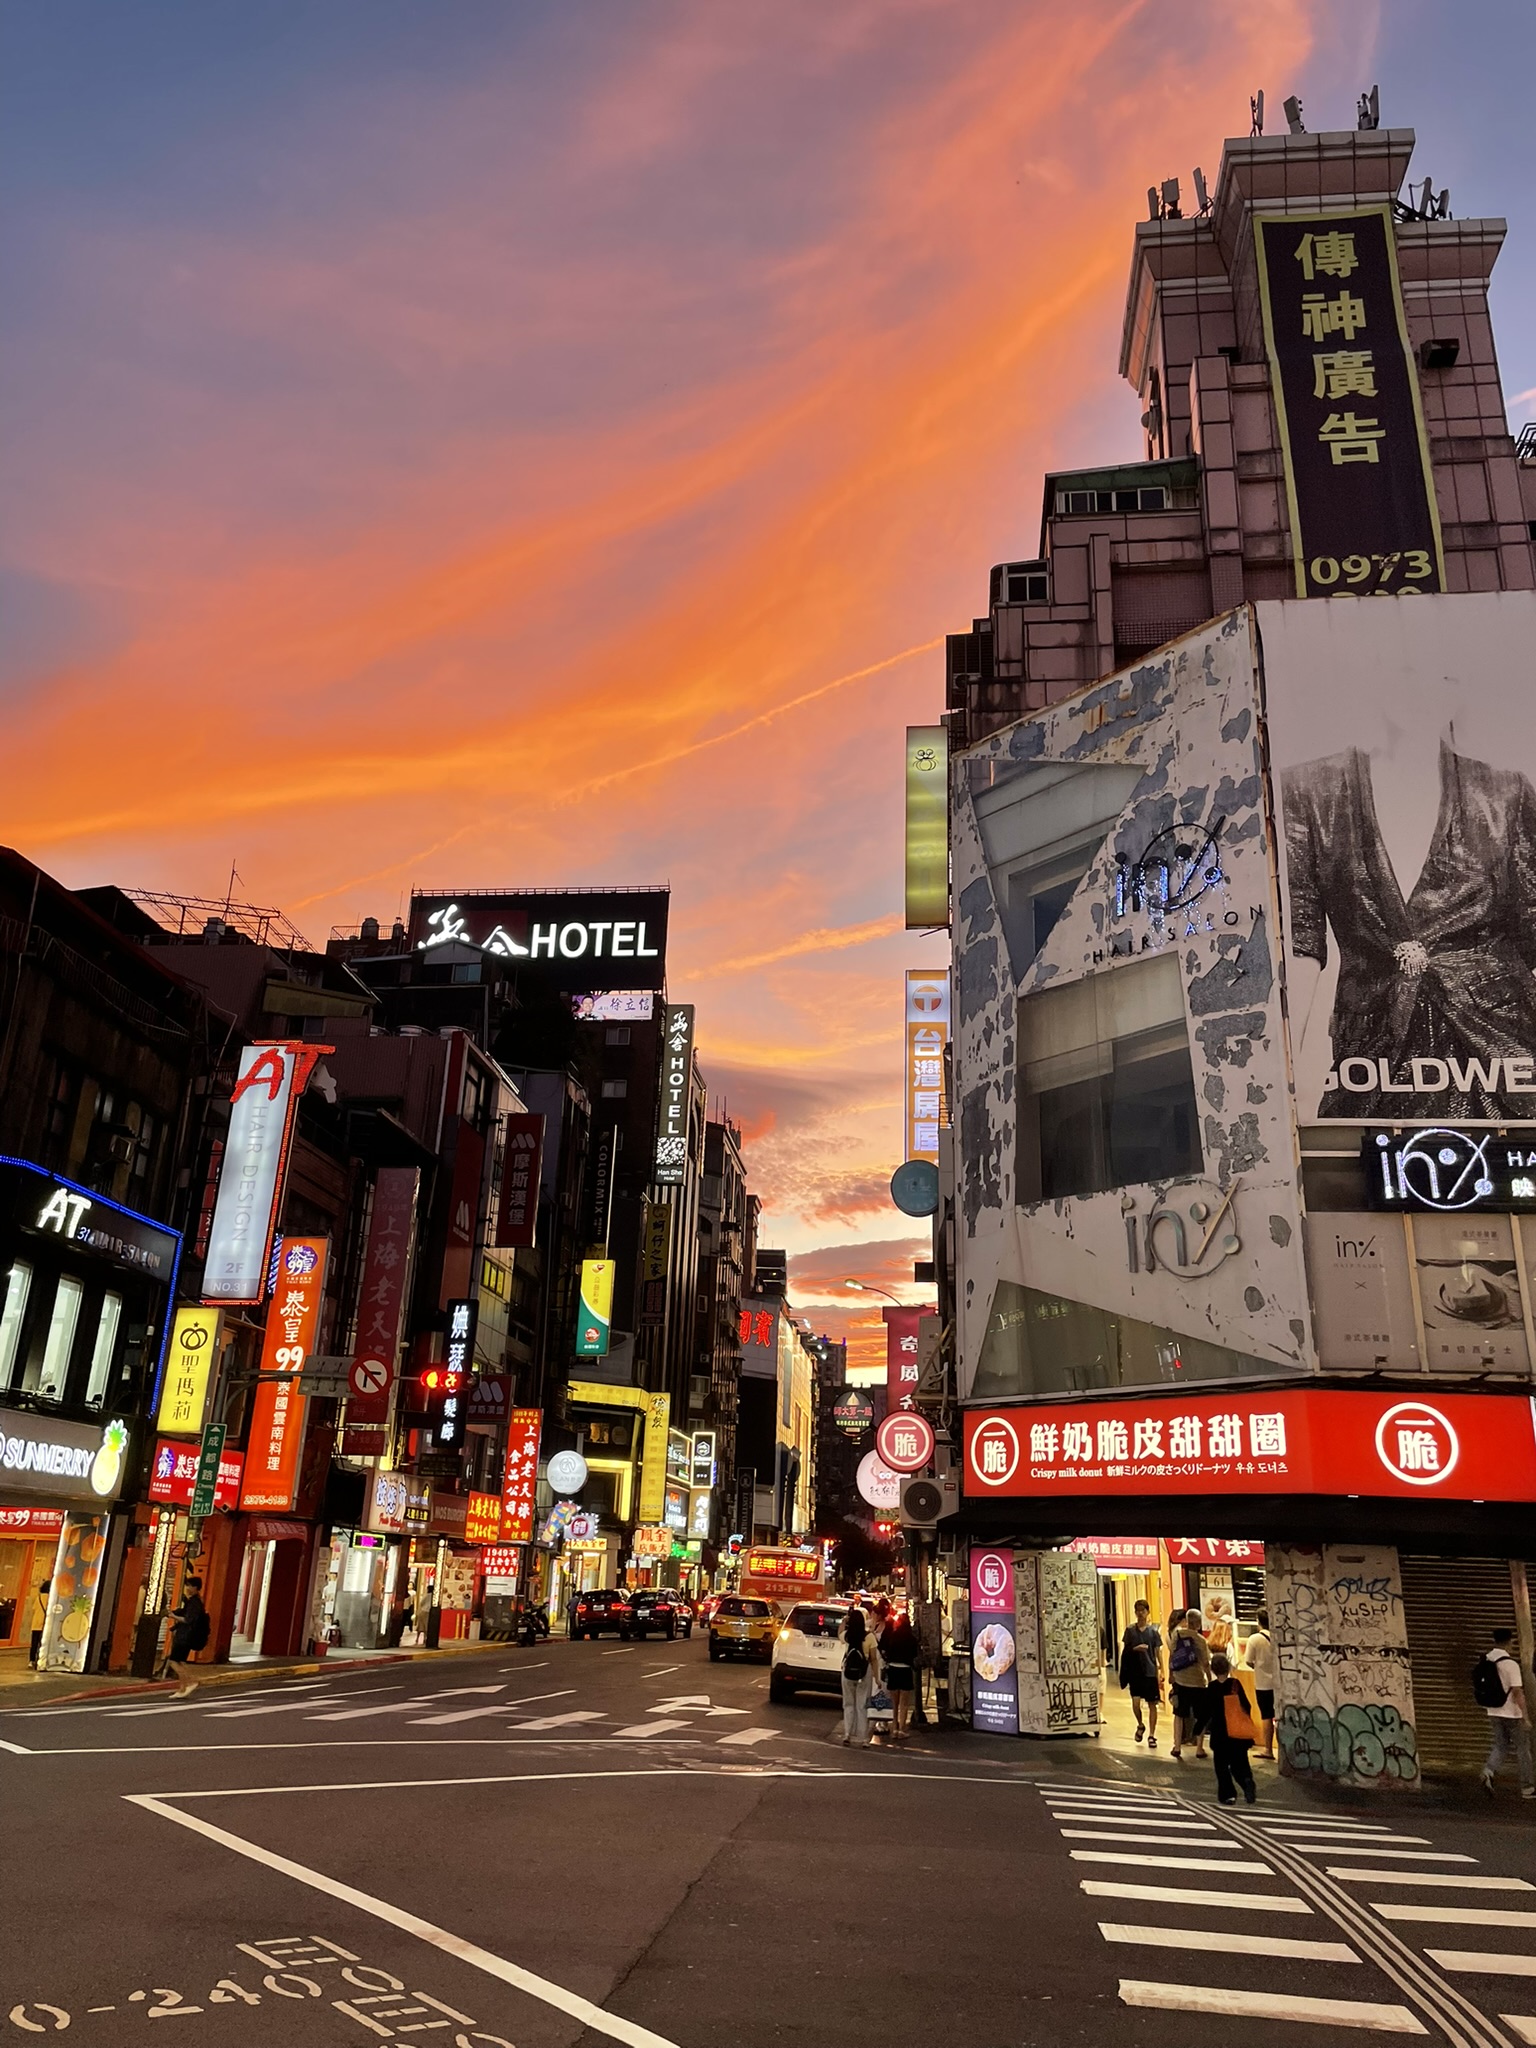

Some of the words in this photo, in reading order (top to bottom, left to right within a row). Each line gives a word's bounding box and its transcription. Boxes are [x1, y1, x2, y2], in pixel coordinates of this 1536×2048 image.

[1294, 230, 1386, 465] 傳神廣告
[1310, 550, 1433, 585] 0973
[530, 921, 658, 959] HOTEL
[1093, 935, 1150, 964] HAIR
[1168, 904, 1264, 941] SALON
[610, 997, 650, 1012] 徐立信
[229, 1044, 336, 1104] AT
[667, 1057, 685, 1135] HOTEL
[913, 1028, 942, 1152] 台灣房屋
[246, 1105, 269, 1155] HAIR
[231, 1165, 259, 1242] DESIGN
[508, 1153, 531, 1225] 摩斯漢堡
[595, 1145, 608, 1215] COLORMIX
[36, 1188, 92, 1239] AT
[212, 1281, 248, 1292] NO.31
[225, 1262, 245, 1274] 2F
[365, 1215, 402, 1357] 上海老天
[275, 1290, 310, 1371] 泰皇99
[172, 1355, 200, 1421] 聖瑪莉
[267, 1381, 290, 1471] 泰國雲南料理
[894, 1426, 918, 1457] 一脆
[1029, 1412, 1287, 1463] 鮮奶脆皮甜甜圈
[1394, 1418, 1440, 1472] 一脆
[4, 1437, 95, 1478] SUNMERRY
[174, 1454, 201, 1480] 泰皇9
[201, 1436, 219, 1481] 成都路
[517, 1425, 538, 1521] 上海老天祿
[983, 1430, 1007, 1474] 一脆
[1031, 1467, 1056, 1479] Crispy
[1059, 1467, 1077, 1477] milk
[1078, 1467, 1103, 1477] donut
[1235, 1462, 1254, 1474] 우유
[1257, 1461, 1288, 1474] 도너츠
[505, 1449, 523, 1516] 食品公司
[486, 1548, 517, 1558] 1949年
[984, 1562, 1000, 1589] 一脆
[765, 1583, 802, 1594] 213-FW
[1213, 1576, 1225, 1588] 61
